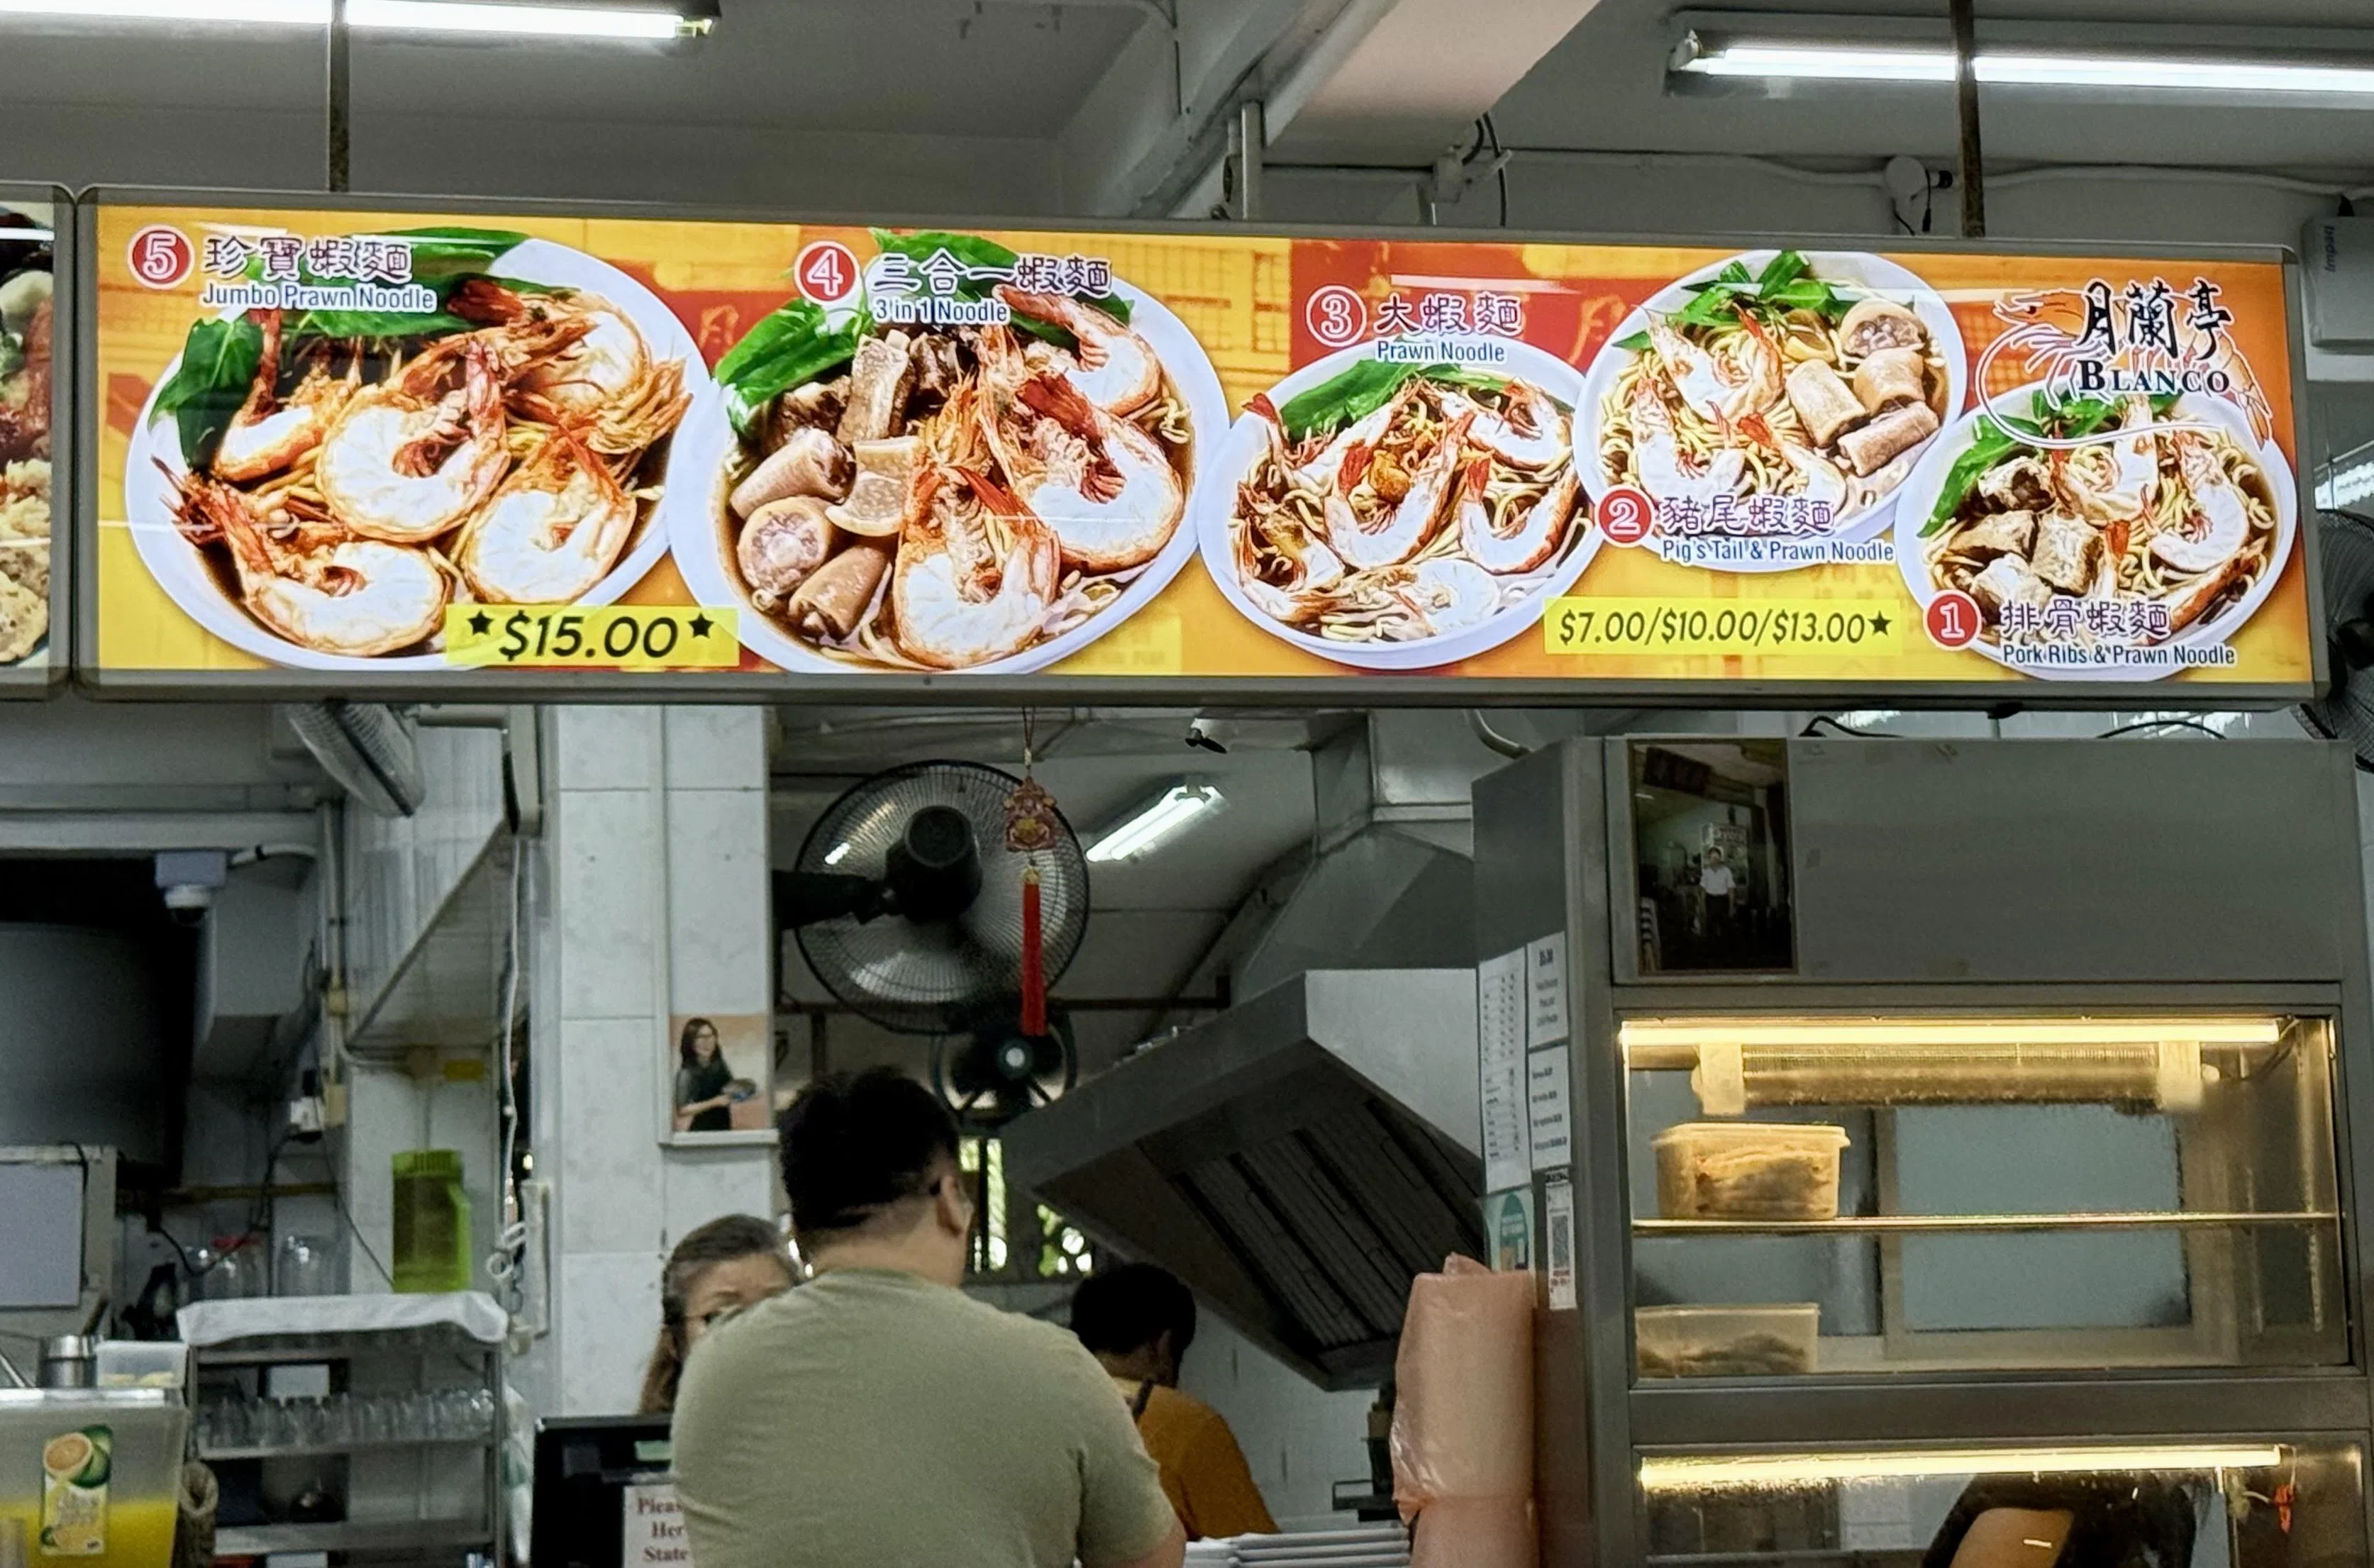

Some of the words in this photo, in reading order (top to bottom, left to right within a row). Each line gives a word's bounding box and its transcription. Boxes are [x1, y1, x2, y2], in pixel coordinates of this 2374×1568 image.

[143, 234, 178, 279] 5
[204, 236, 412, 281] 珍寶蝦麵
[808, 250, 843, 296] 4
[873, 249, 1112, 296] 三合一蝦麵
[204, 287, 276, 306] Jumbo
[285, 287, 351, 308] Prawn
[359, 288, 434, 310] Noodle
[876, 299, 887, 321] 3
[895, 299, 914, 321] in
[921, 300, 928, 322] 1
[938, 301, 1008, 323] Noodle
[1321, 295, 1352, 338] 3
[1377, 294, 1521, 334] 大蝦麵
[1377, 340, 1434, 360] Prawn
[1441, 342, 1504, 362] Noodle
[2078, 360, 2230, 393] BLANCO
[1608, 497, 1641, 535] 2
[1661, 495, 1834, 534] 豬尾蝦麵
[1663, 540, 1707, 562] Pig's
[1713, 541, 1744, 560] Tail
[1751, 542, 1763, 560] &
[1770, 542, 1825, 560] Prawn
[1832, 542, 1895, 562] Noodle
[499, 609, 678, 661] $15.00
[1560, 606, 1865, 646] $7.00/$10.00/$13.00
[1940, 602, 1966, 638] 1
[2002, 599, 2170, 637] 排骨蝦麵
[2004, 645, 2042, 665] Pork
[2049, 645, 2087, 665] Ribs
[2094, 646, 2107, 664] &
[2114, 645, 2168, 665] Prawn
[2175, 645, 2235, 665] Noodle
